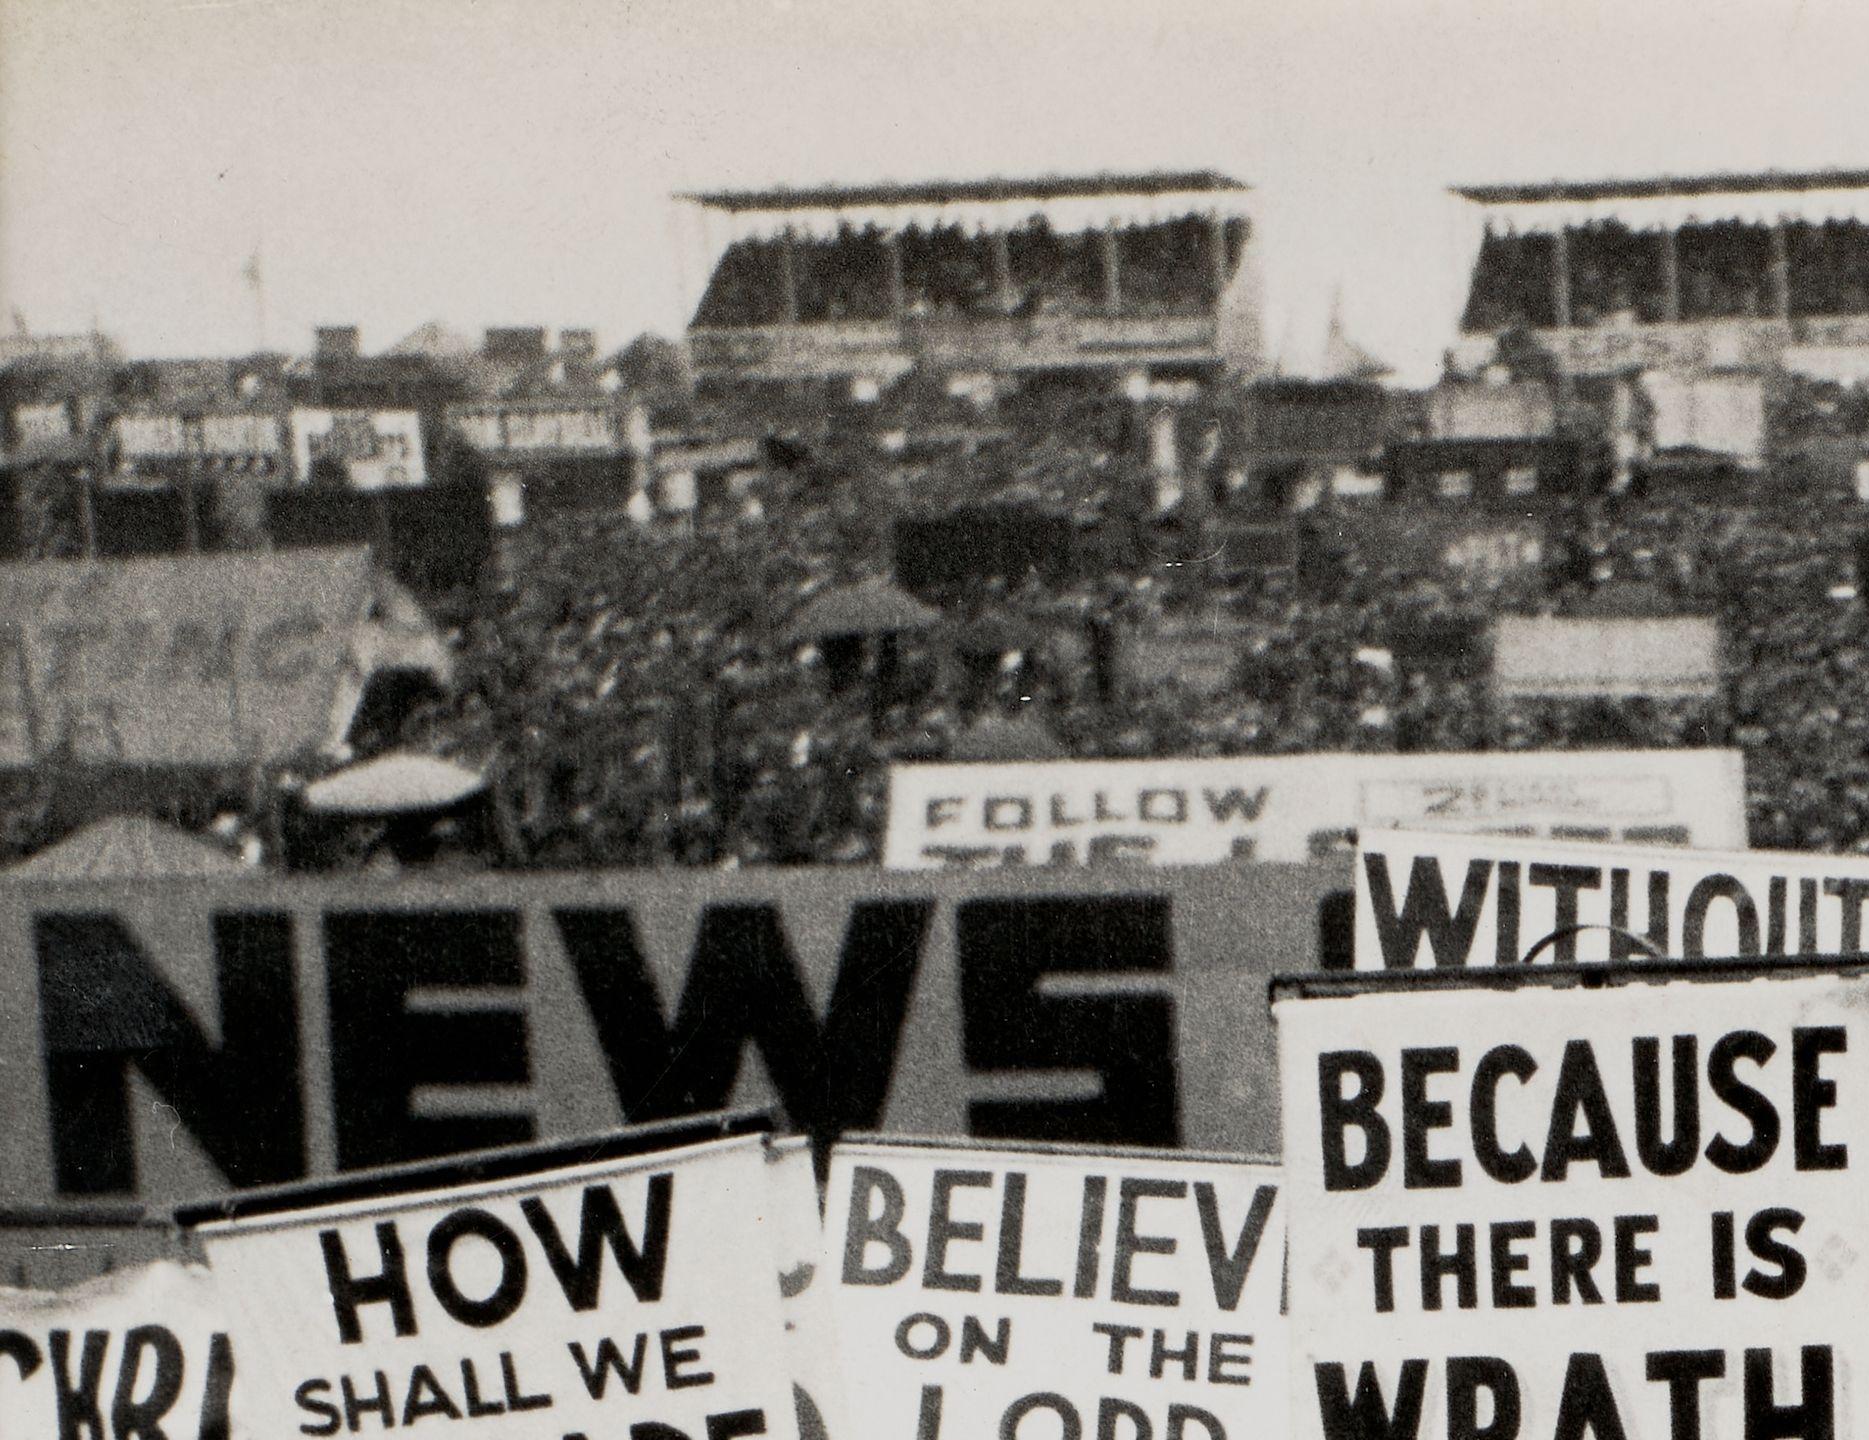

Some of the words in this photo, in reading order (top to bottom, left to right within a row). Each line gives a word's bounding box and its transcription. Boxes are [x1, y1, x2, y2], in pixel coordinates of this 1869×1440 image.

[924, 785, 1271, 831] FOLLOW
[32, 893, 1181, 1197] NEWS
[1317, 1025, 1850, 1193] BECAUSE
[318, 1171, 676, 1345] HOW
[841, 1164, 1288, 1317] BELIEV
[1356, 1214, 1661, 1313] THERE
[1711, 1206, 1809, 1301] IS
[293, 1350, 552, 1438] SHALL
[566, 1324, 716, 1401] WE
[894, 1311, 1011, 1366] ON
[1092, 1321, 1256, 1387] THE
